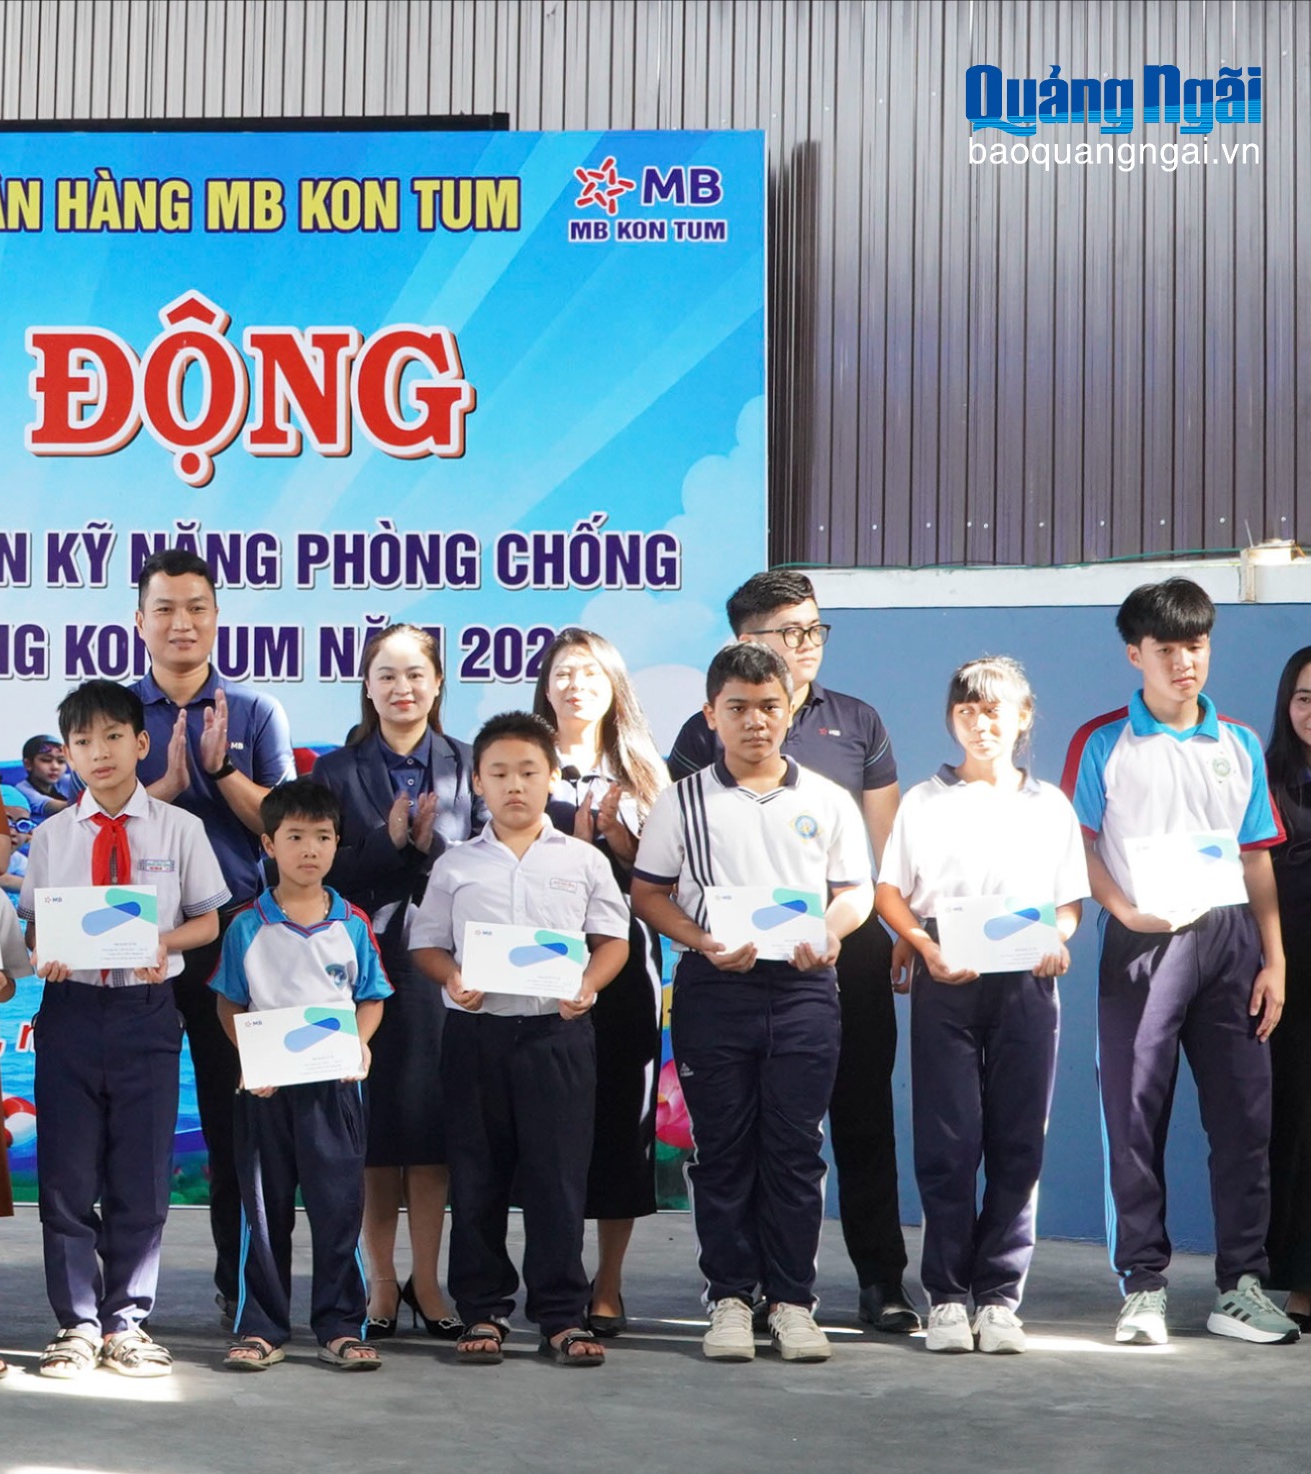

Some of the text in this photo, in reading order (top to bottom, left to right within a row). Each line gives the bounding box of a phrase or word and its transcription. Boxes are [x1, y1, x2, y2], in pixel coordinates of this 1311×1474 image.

[55, 168, 191, 233] HÀNG
[206, 177, 285, 233] MB
[299, 177, 397, 232] KON
[413, 177, 521, 232] TUM
[642, 168, 722, 205] MB
[570, 221, 726, 240] MB KON TUM
[26, 291, 474, 486] ĐỘNG
[46, 521, 113, 585] KỸ
[296, 520, 478, 586] PHÒNG
[496, 514, 678, 587] CHỐNG
[459, 626, 579, 679] 202
